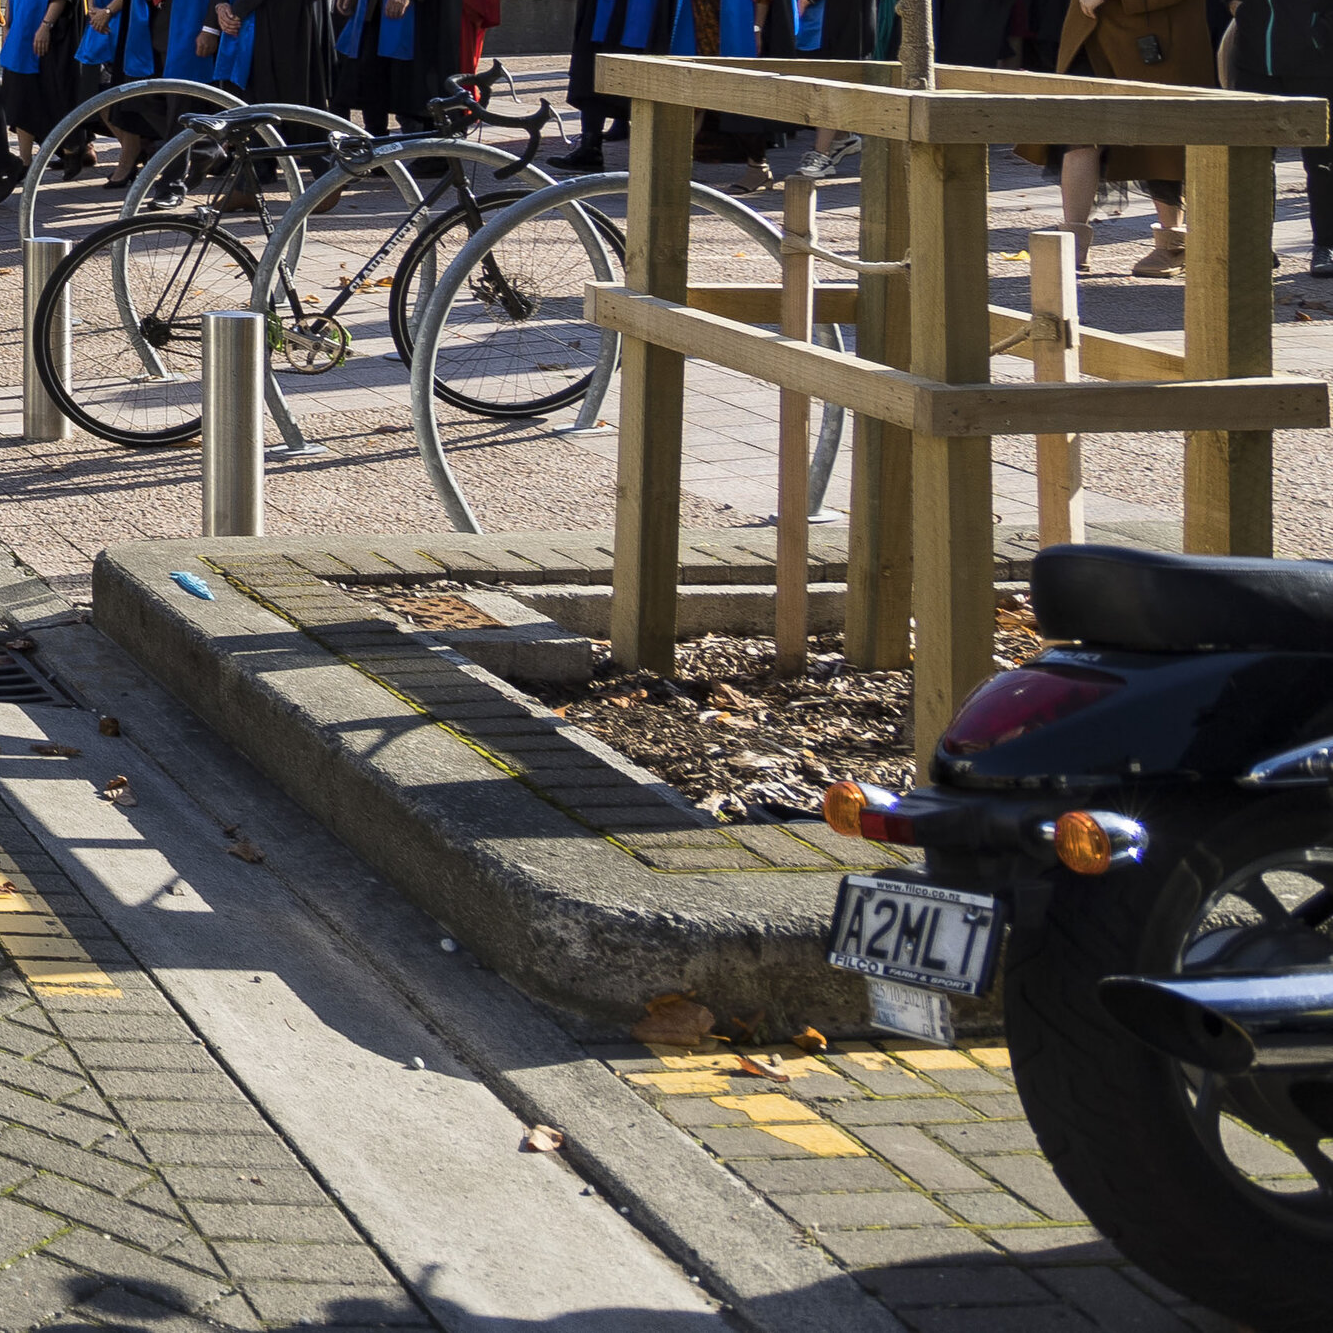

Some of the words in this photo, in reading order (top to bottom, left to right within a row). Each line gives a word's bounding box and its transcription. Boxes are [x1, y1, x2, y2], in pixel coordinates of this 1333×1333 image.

[876, 881, 961, 902] www.filco.co.nz
[841, 895, 989, 975] A2MLT
[835, 954, 879, 973] FILCO
[889, 968, 918, 981] FARM
[919, 974, 928, 982] &
[930, 977, 968, 990] SPORT
